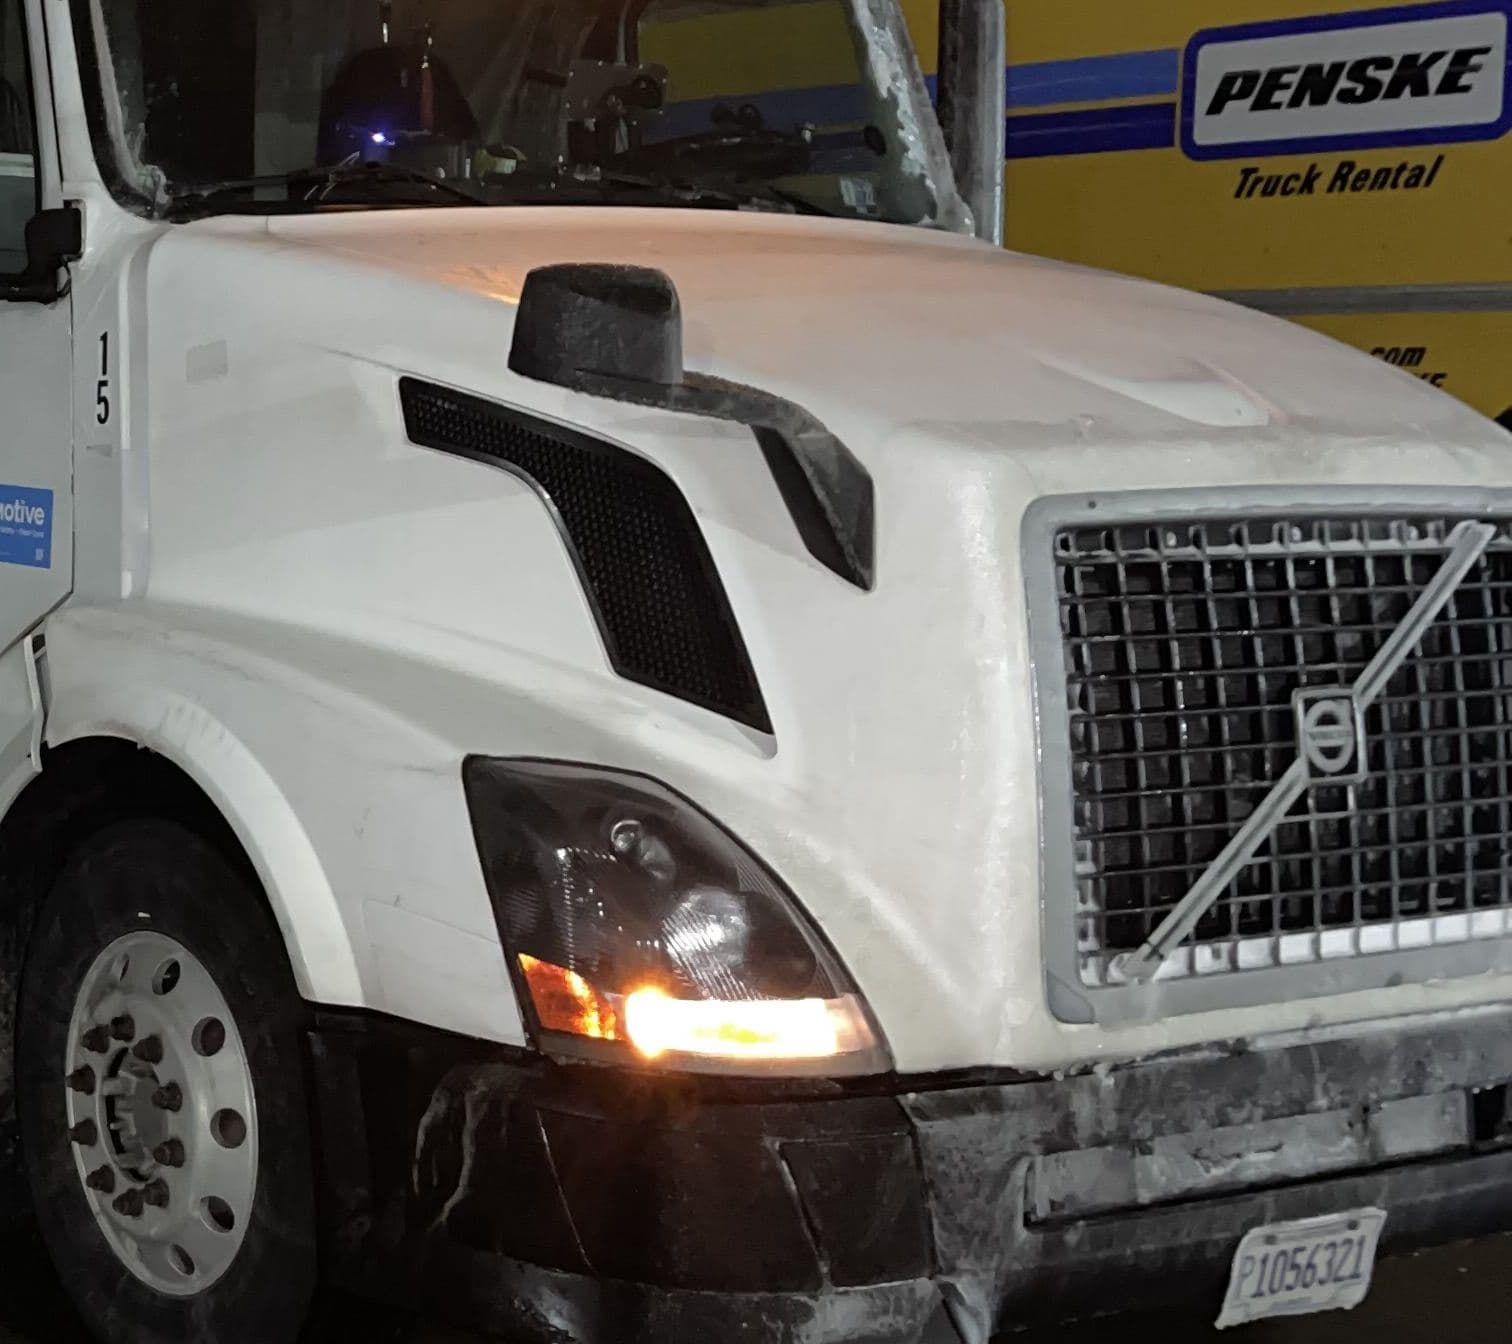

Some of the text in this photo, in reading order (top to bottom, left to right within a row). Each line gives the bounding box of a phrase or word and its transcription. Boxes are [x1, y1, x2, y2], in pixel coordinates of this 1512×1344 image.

[1206, 46, 1492, 116] PENSKE
[1234, 154, 1445, 199] Truck Rental
